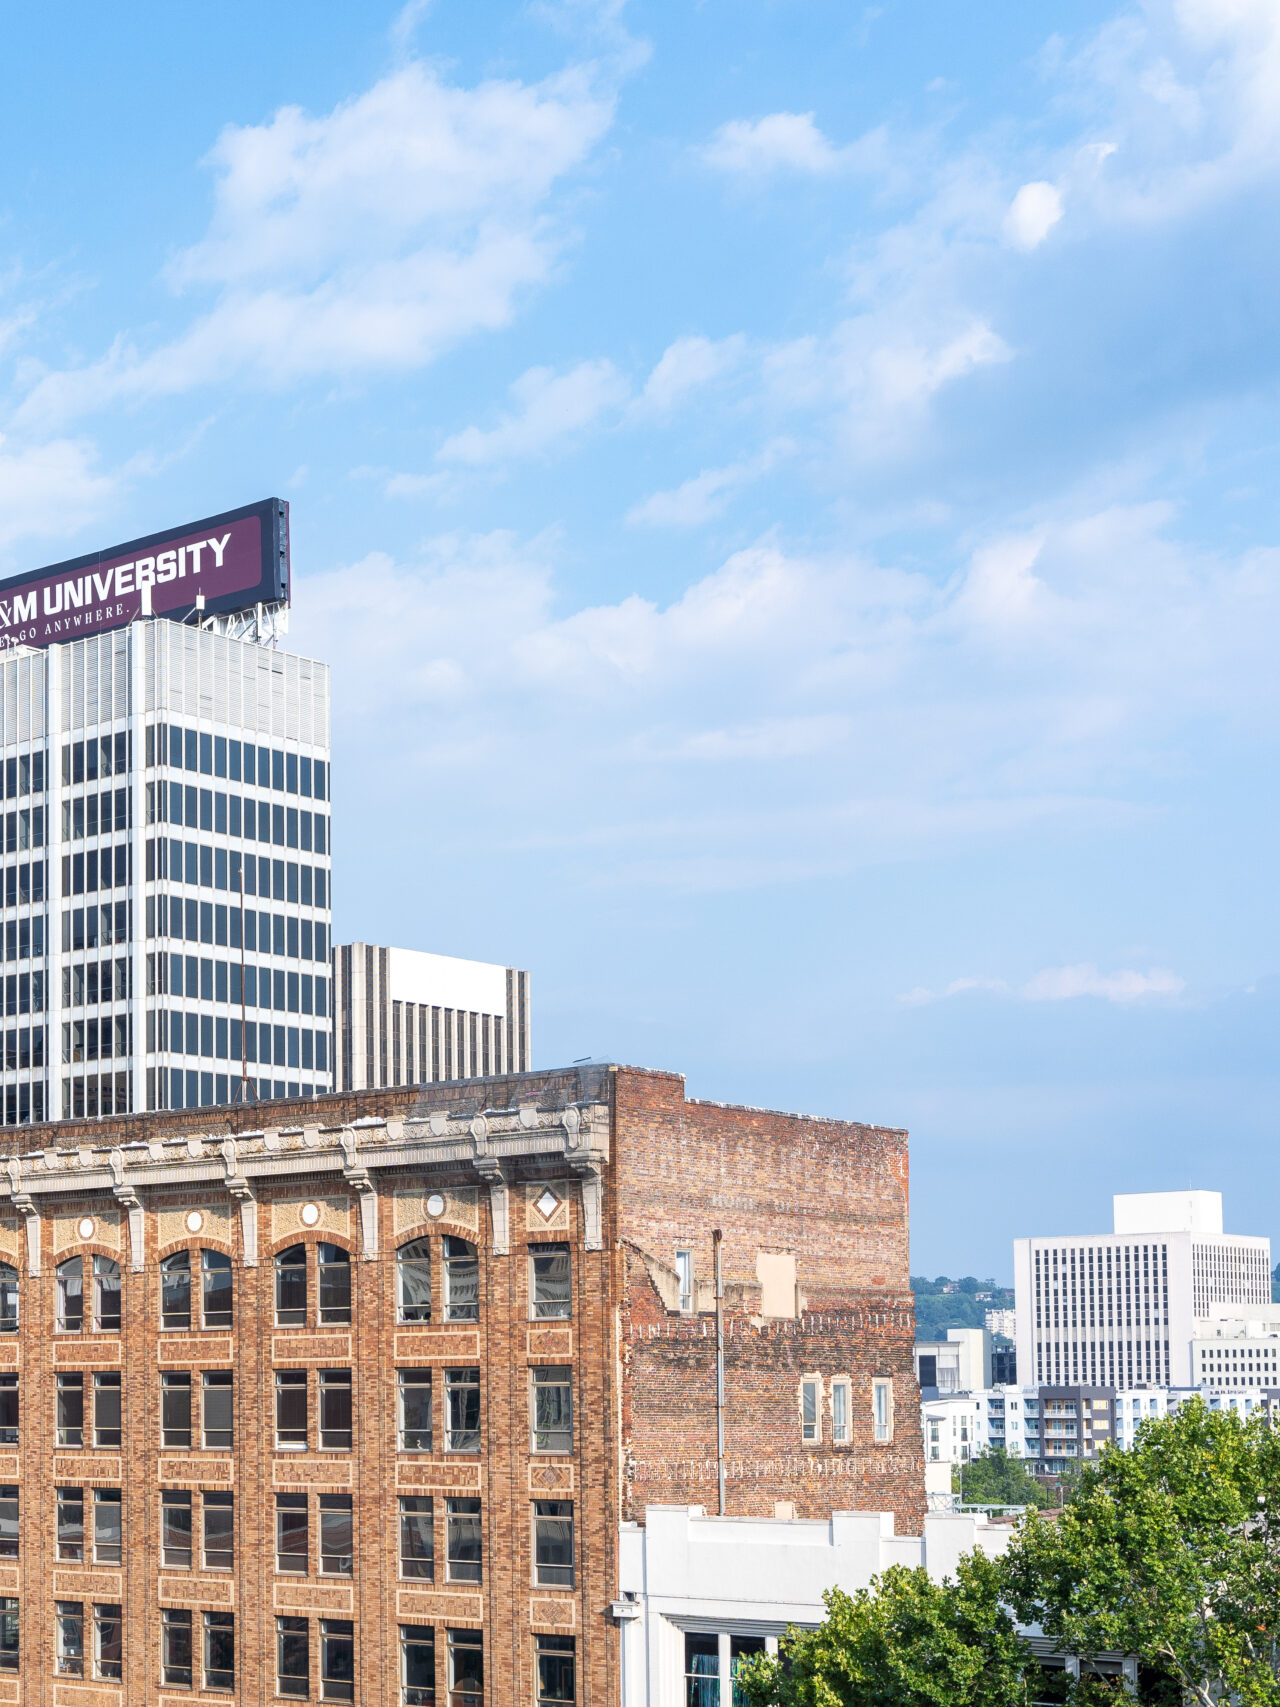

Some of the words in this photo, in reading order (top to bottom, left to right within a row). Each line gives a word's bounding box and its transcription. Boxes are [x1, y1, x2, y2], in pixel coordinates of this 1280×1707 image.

[43, 532, 232, 616] UNIVERSITY
[19, 627, 37, 642] GO
[44, 603, 129, 635] ANYWHERE.
